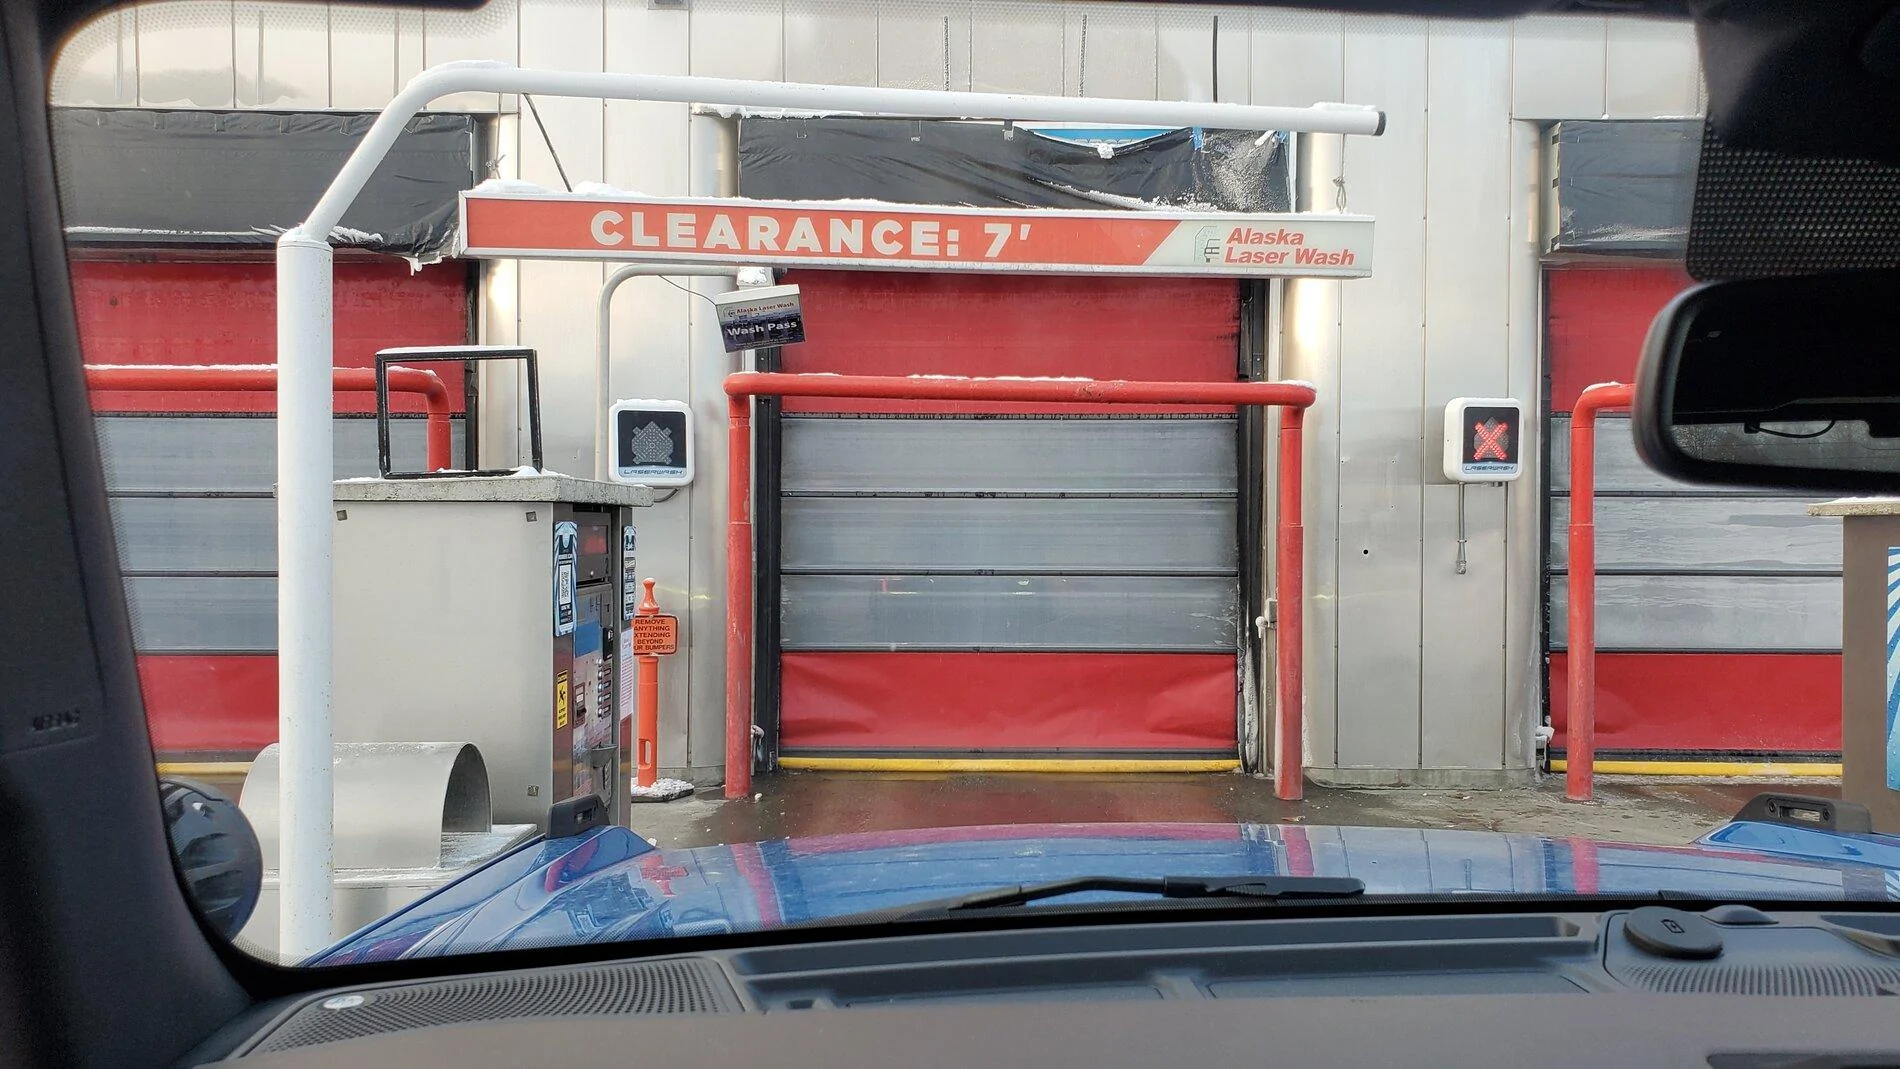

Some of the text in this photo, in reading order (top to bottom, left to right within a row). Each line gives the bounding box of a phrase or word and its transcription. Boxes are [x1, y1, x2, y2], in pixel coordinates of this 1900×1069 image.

[590, 209, 1032, 258] CLEARANCE: 7'
[1226, 227, 1305, 246] Alaska
[1224, 246, 1356, 266] Laser Wash
[736, 301, 795, 314] Alaska Laser Wash
[726, 321, 798, 336] Wash Pass
